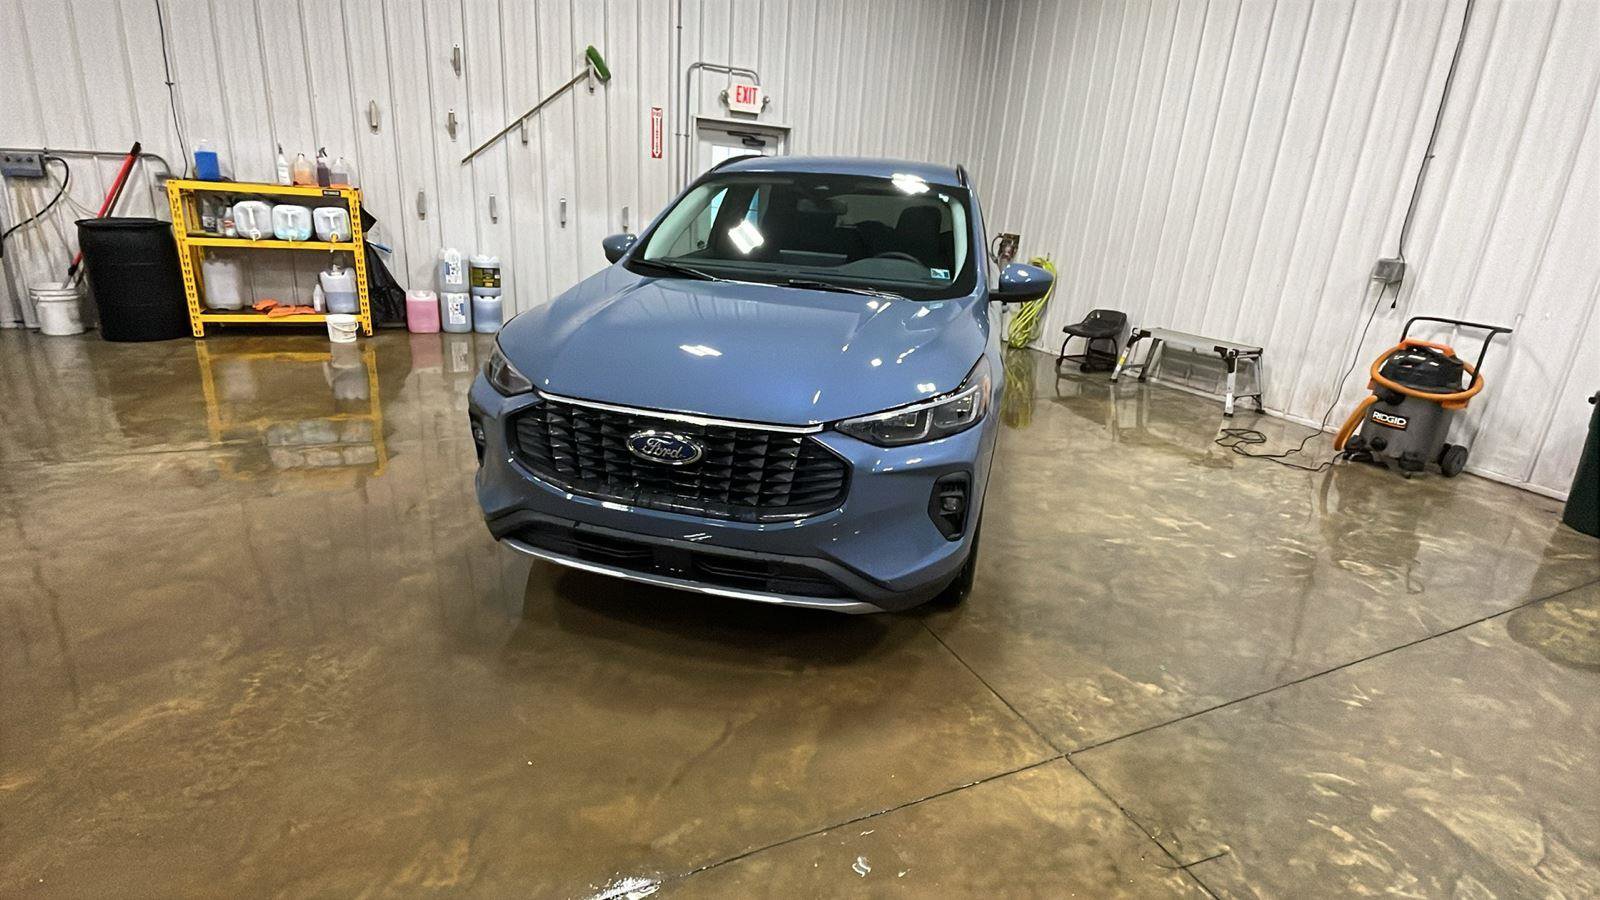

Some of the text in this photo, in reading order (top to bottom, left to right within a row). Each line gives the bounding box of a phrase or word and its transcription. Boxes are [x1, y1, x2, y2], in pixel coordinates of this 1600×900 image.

[736, 85, 758, 105] EXIT
[1372, 411, 1407, 426] RIDGID
[642, 437, 683, 459] Ford
